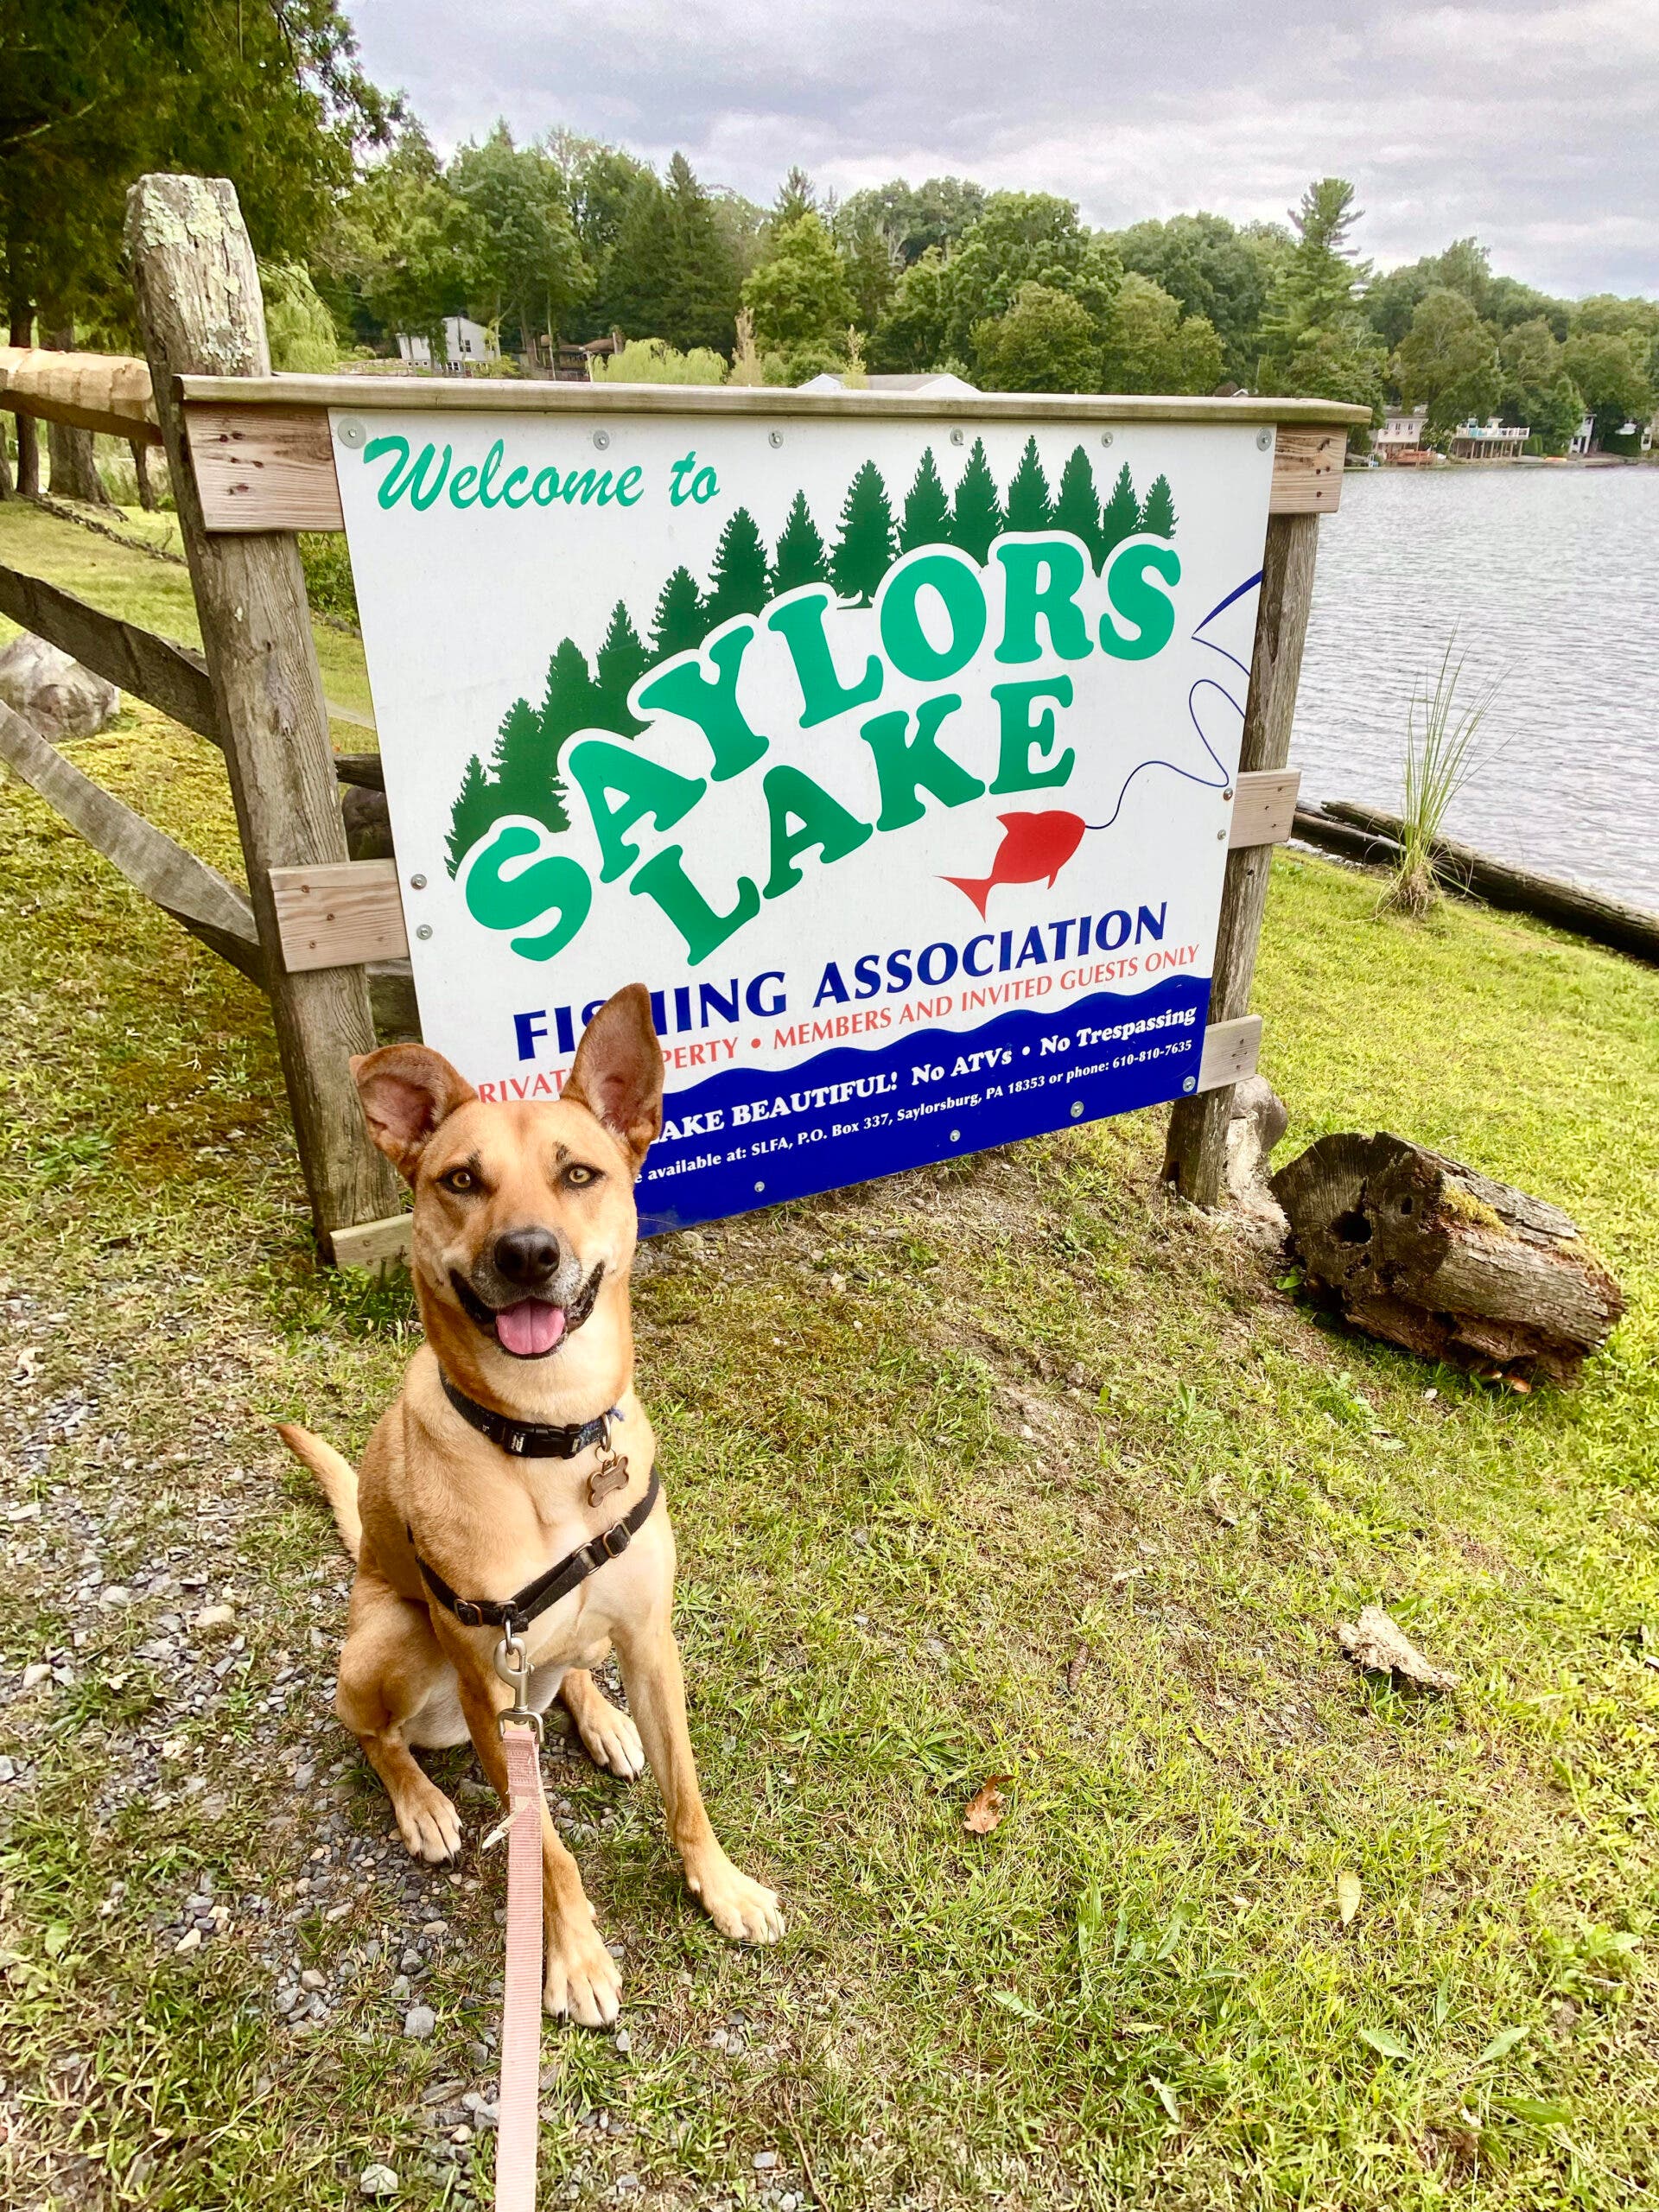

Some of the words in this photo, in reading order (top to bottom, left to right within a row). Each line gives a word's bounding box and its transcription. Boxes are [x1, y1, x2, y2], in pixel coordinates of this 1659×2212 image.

[363, 435, 645, 512] Welcome
[669, 451, 721, 507] to
[465, 541, 1181, 962] SAYLORS
[630, 674, 1076, 966] LAKE
[478, 1067, 572, 1103] RIVAT
[663, 1037, 738, 1071] PERTY
[774, 1007, 892, 1050] MEMBERS
[899, 995, 952, 1024] AND
[962, 976, 1052, 1011] INVITED
[1060, 957, 1138, 990] GUESTS
[1145, 944, 1199, 972] ONLY
[812, 901, 1167, 1008] ASSOCIATION
[647, 1153, 721, 1181] available
[726, 1147, 747, 1160] at:
[751, 1137, 794, 1156] SLFA,
[798, 1128, 827, 1145] P.O.
[832, 1122, 860, 1137] Box
[863, 1113, 893, 1129] 337,
[897, 1092, 982, 1121] Saylorsburg,
[986, 1086, 1003, 1099] PA
[1007, 1077, 1046, 1095] 18353
[1048, 1072, 1063, 1084] or
[1066, 1061, 1109, 1084] phone:
[1112, 1039, 1192, 1069] 610-810-7635
[649, 1109, 724, 1145] AKE
[732, 1071, 898, 1127] BEAUTIFUL!
[912, 1064, 945, 1086] No
[950, 1047, 1013, 1077] ATVs
[1039, 1035, 1071, 1056] No
[1077, 1007, 1198, 1047] Trespassing
